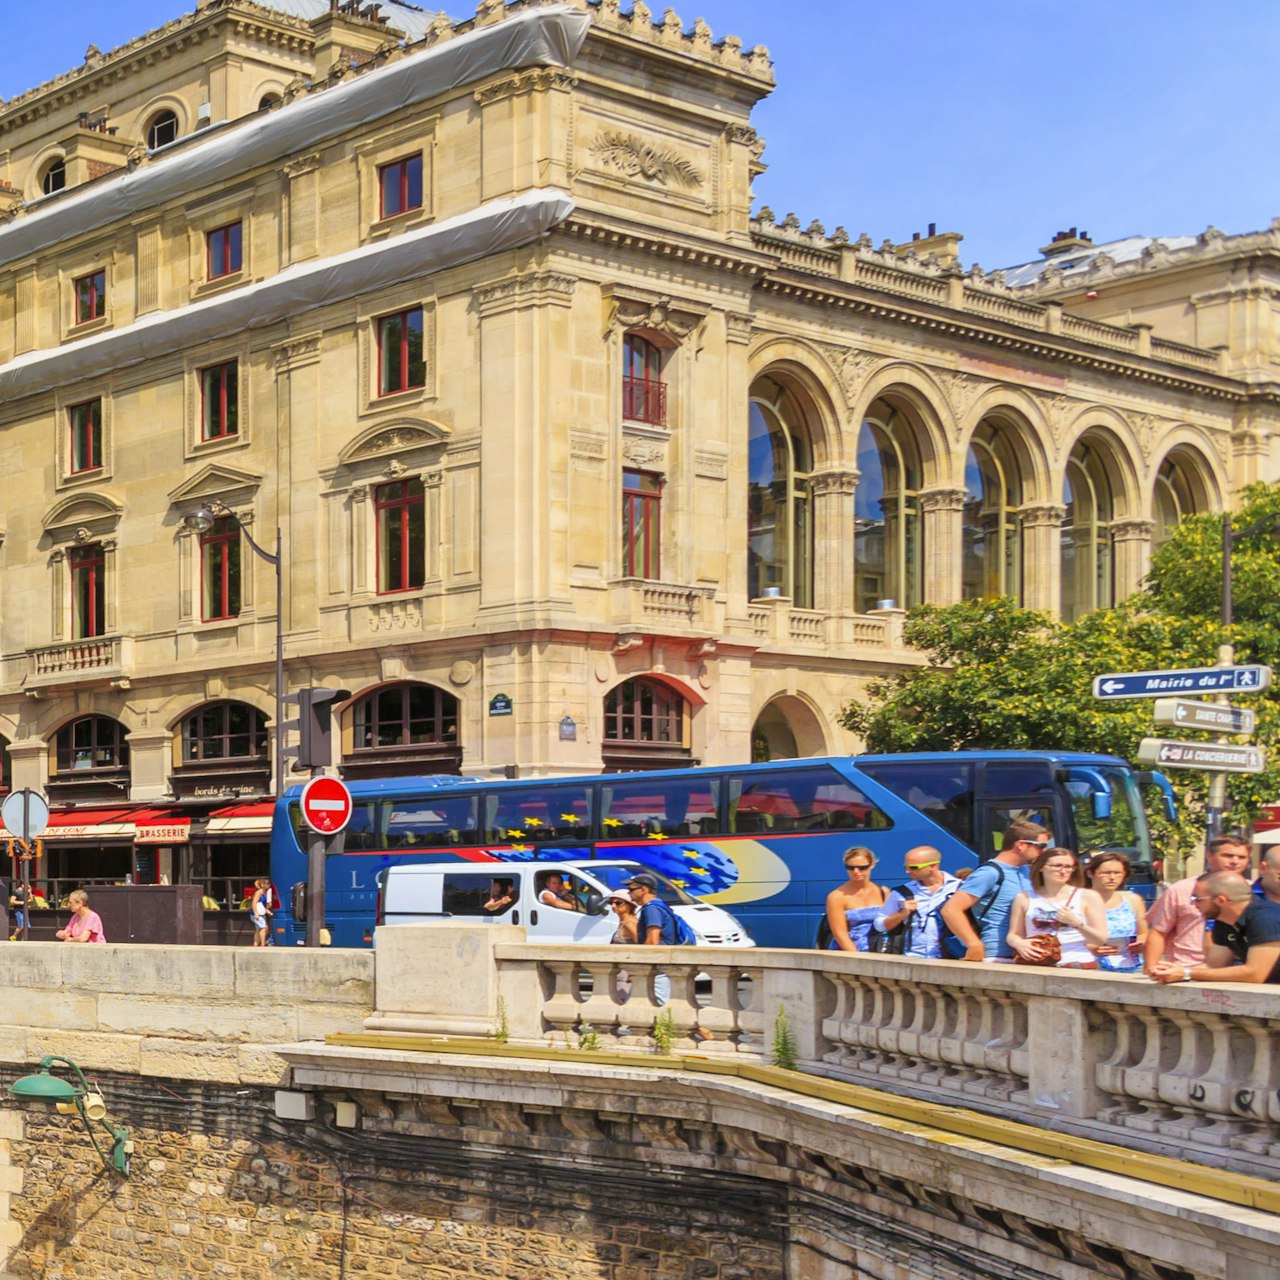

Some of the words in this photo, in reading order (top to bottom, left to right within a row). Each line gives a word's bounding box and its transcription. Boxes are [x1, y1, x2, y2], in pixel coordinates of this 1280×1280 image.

[1145, 676, 1193, 690] Mairie
[1198, 675, 1217, 687] du
[1195, 709, 1217, 722] SAINTE
[1183, 749, 1193, 760] LA
[1194, 750, 1247, 764] CONCIERGERIE
[194, 786, 218, 796] bords
[46, 827, 60, 835] DE
[63, 826, 88, 834] SEINE
[140, 828, 185, 838] BRASSERIE
